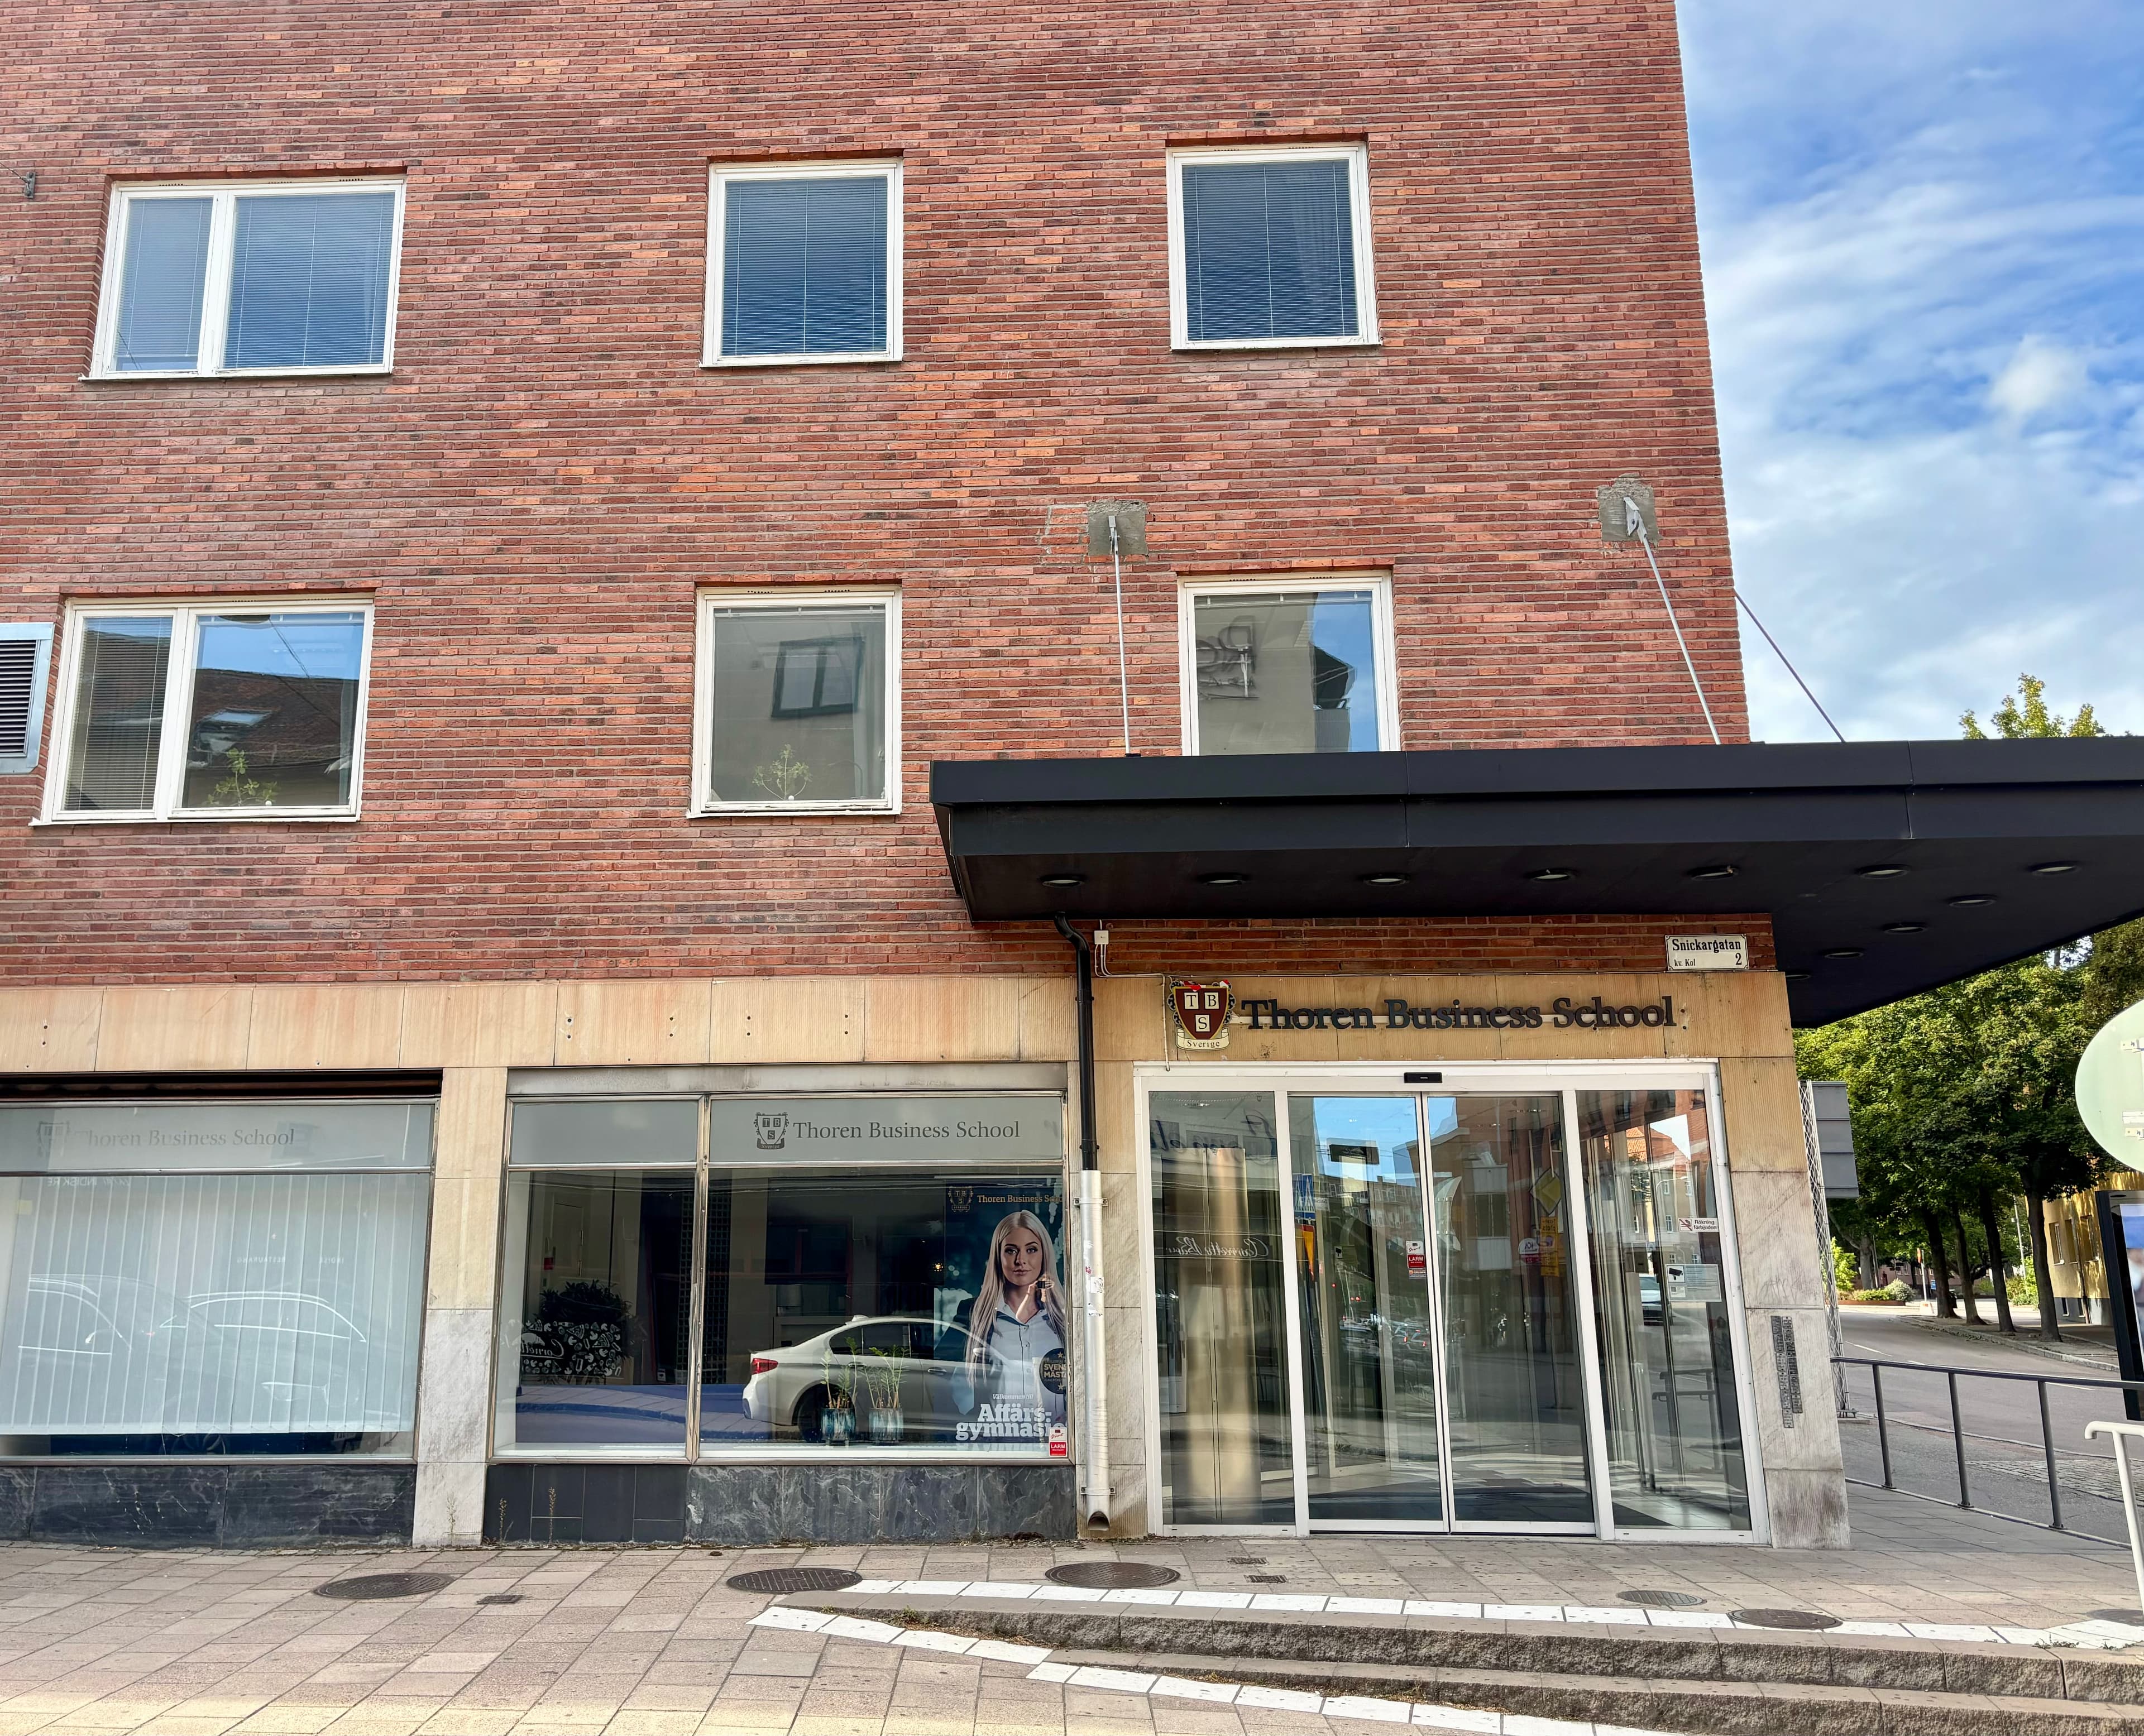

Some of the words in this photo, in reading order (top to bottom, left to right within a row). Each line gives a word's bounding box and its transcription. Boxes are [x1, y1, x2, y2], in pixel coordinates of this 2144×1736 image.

[1672, 939, 1741, 953] Snickargatan
[1735, 953, 1742, 965] 2
[1186, 995, 1197, 1007] T
[1207, 995, 1217, 1006] B
[1241, 999, 1376, 1029] Thoren
[1384, 999, 1542, 1029] Business
[1553, 996, 1677, 1028] School
[1198, 1017, 1207, 1029] S
[793, 1122, 862, 1139] Thoren
[868, 1121, 950, 1138] Business
[956, 1120, 1021, 1139] School
[148, 1129, 227, 1146] Business
[233, 1128, 295, 1145] School
[1007, 1195, 1043, 1203] Business
[978, 1403, 1052, 1422] Affärs-
